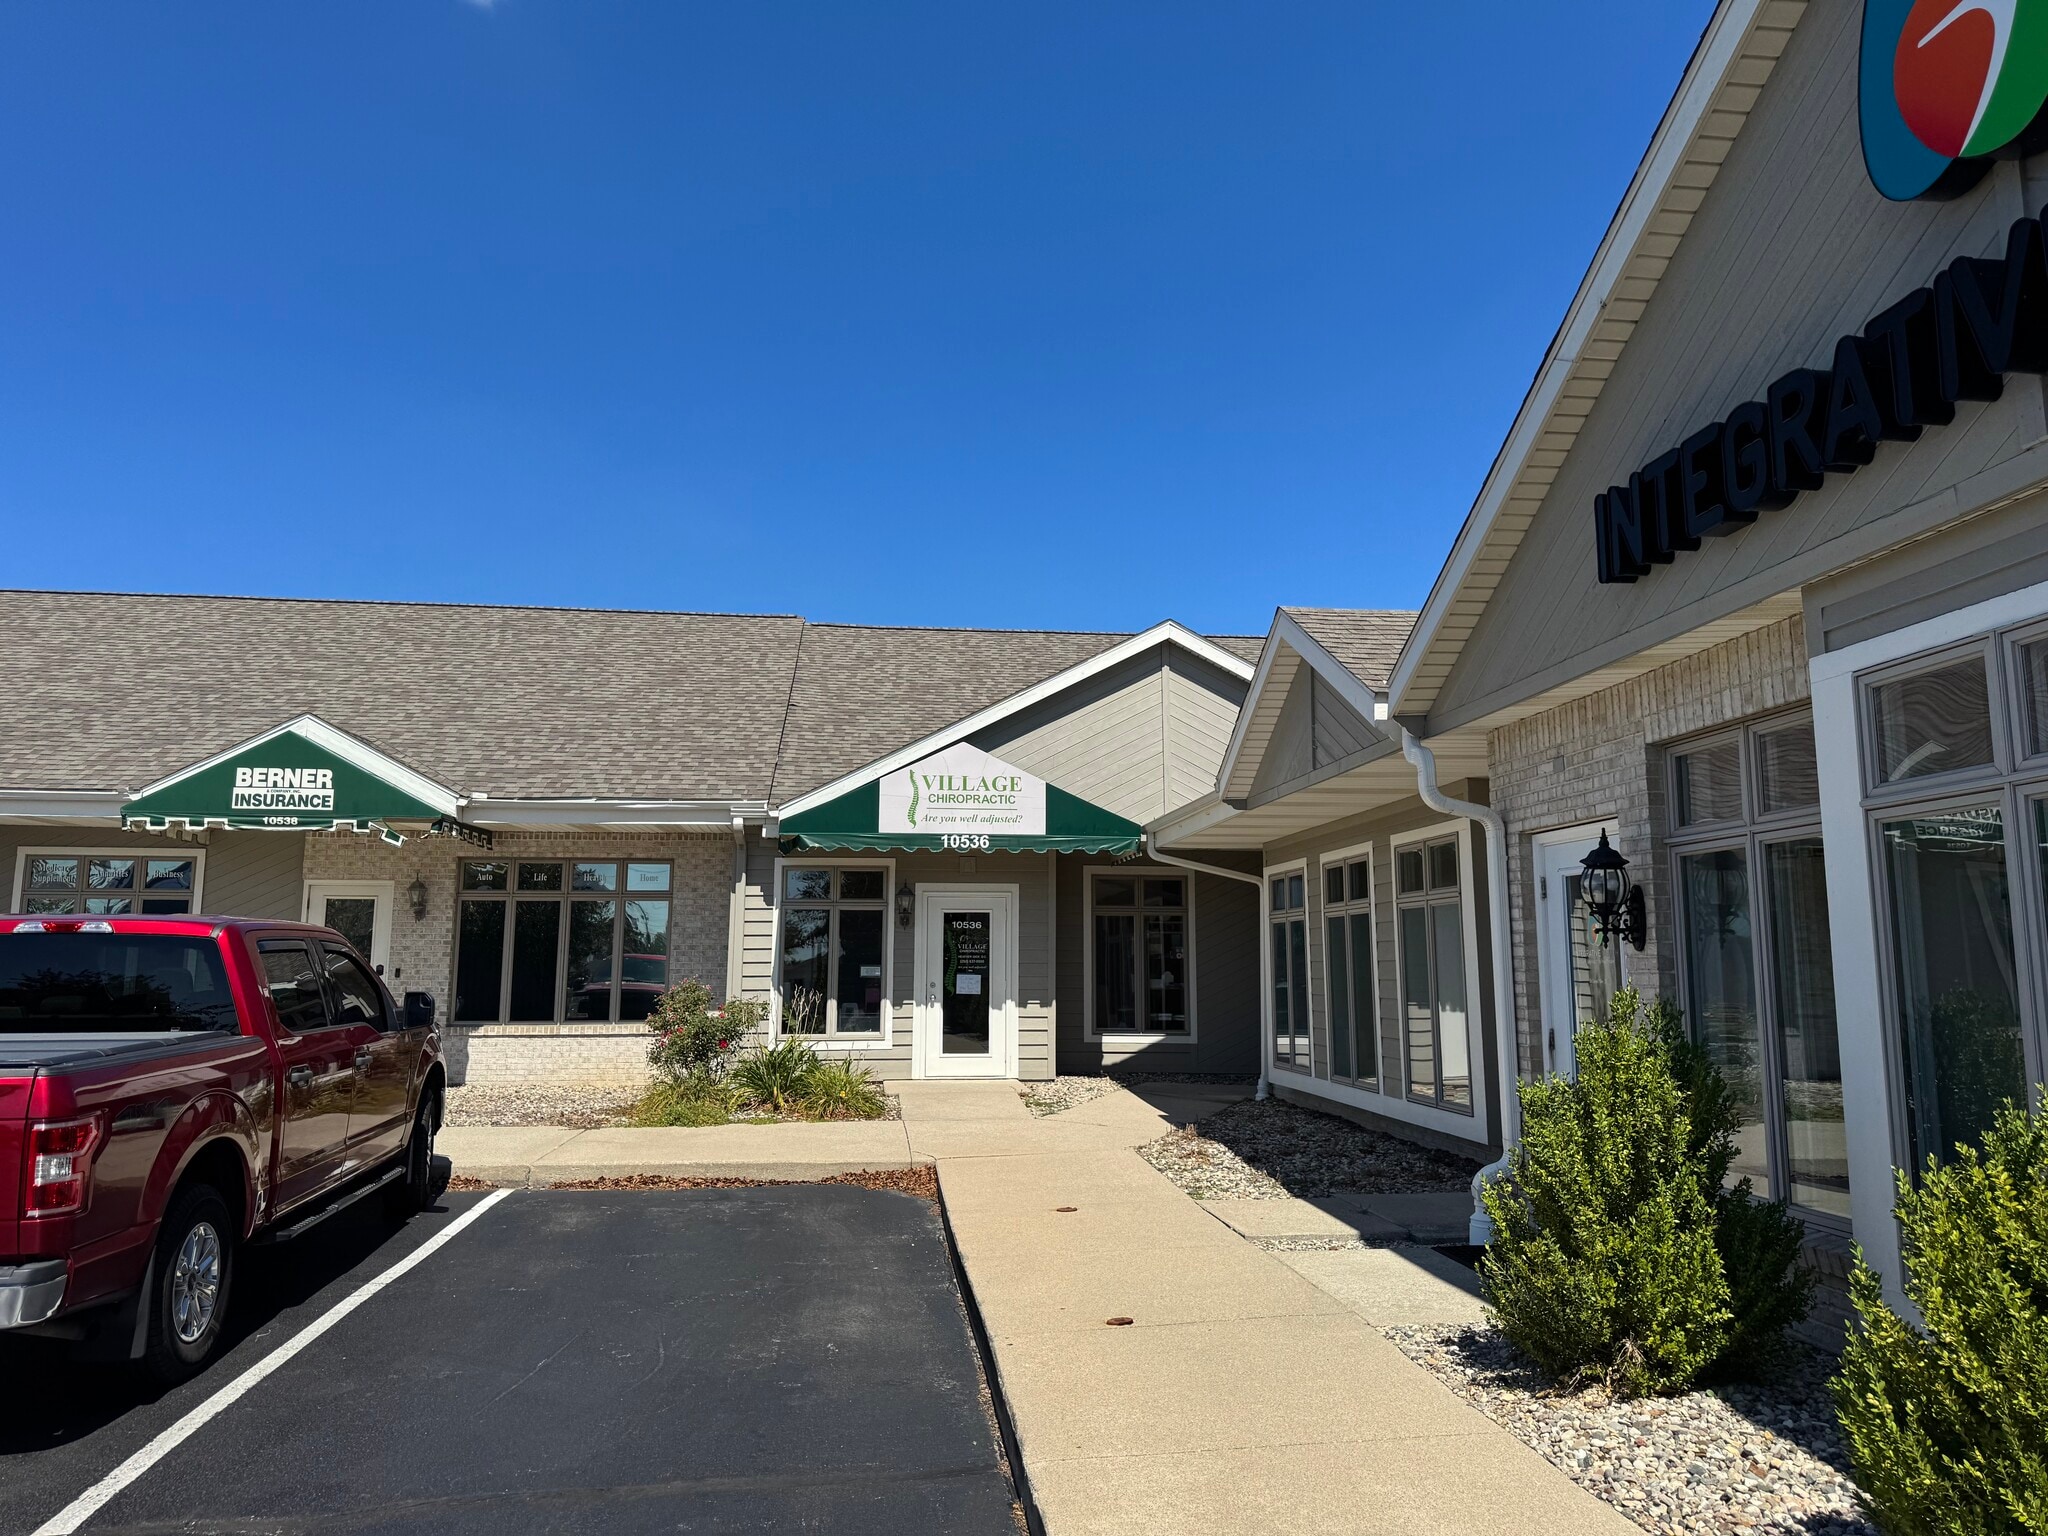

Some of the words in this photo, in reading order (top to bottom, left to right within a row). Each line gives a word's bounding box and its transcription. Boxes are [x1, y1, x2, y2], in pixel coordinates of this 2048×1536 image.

[1594, 203, 2048, 584] INTEGRATIV
[235, 767, 333, 789] BERNER
[921, 774, 1023, 792] VILLAGE
[234, 793, 332, 808] INSURANCE
[928, 793, 1016, 805] CHIROPRACTIC
[262, 816, 299, 825] 10538
[921, 813, 938, 823] Are
[939, 815, 957, 825] you
[959, 814, 978, 823] well
[980, 814, 1023, 825] adjusted?
[940, 834, 990, 849] 10536
[154, 868, 184, 878] Business
[476, 873, 493, 881] Auto
[533, 873, 548, 881] Life
[583, 873, 607, 882] Health
[640, 873, 659, 882] Home
[952, 921, 982, 929] 10536
